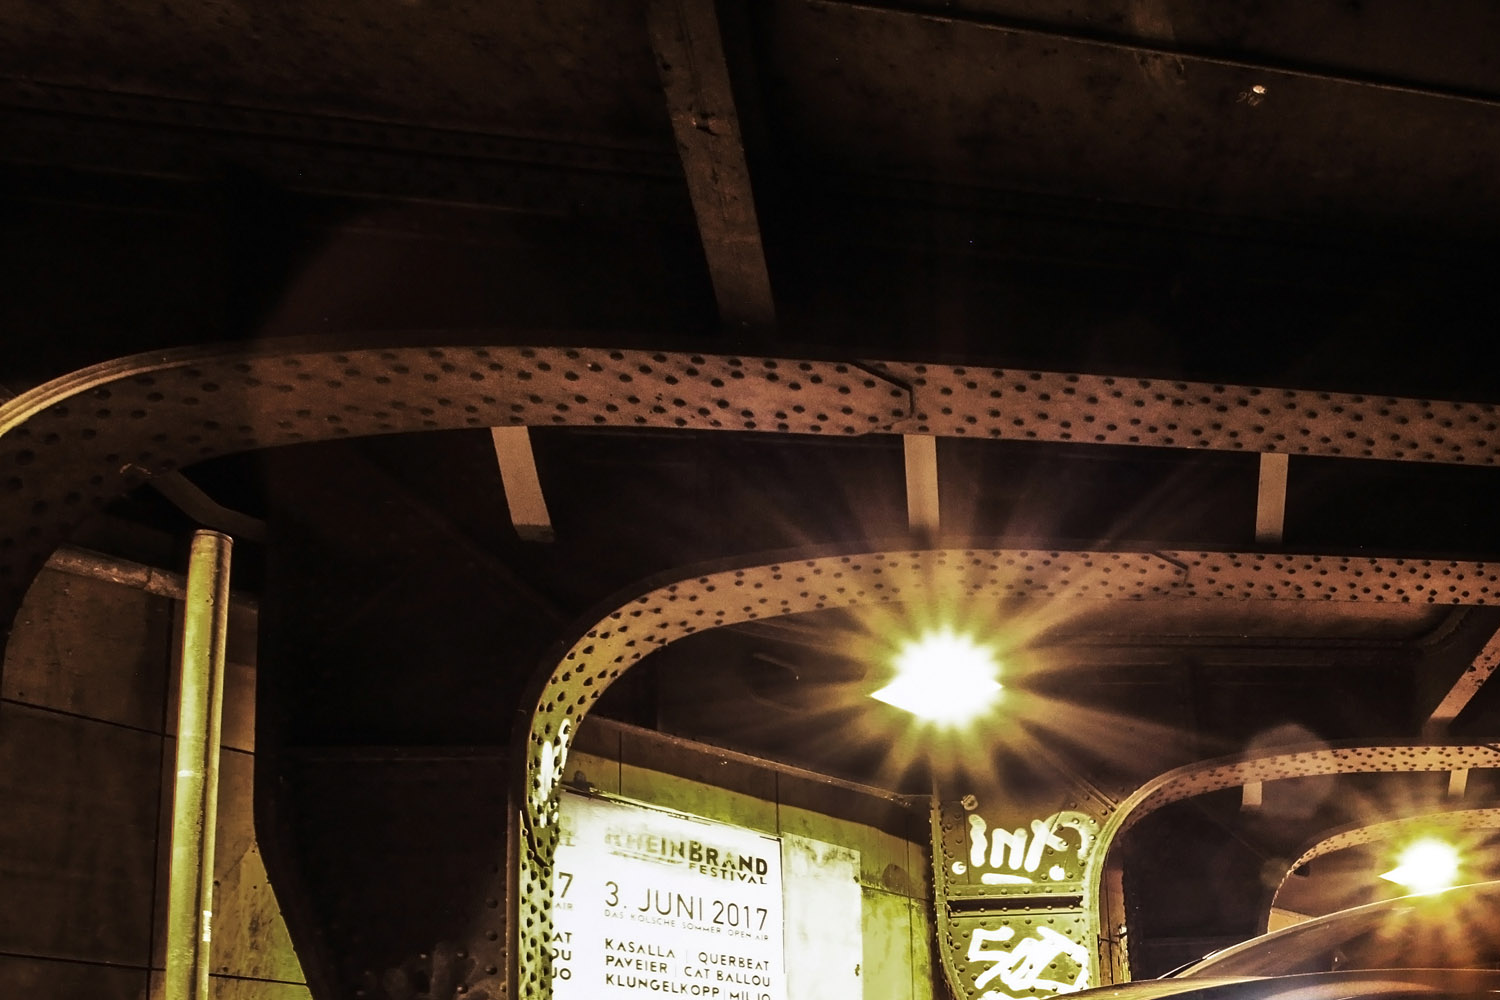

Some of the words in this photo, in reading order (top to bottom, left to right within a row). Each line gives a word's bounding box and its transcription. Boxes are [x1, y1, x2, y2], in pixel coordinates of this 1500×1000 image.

[688, 862, 768, 885] FESTIVAL
[604, 880, 627, 909] 3.
[637, 888, 703, 921] JUNI
[712, 900, 768, 931] 2017
[604, 909, 624, 920] DAS
[682, 921, 722, 934] SOMMER
[727, 929, 752, 938] OPEN
[604, 938, 675, 959] KASALLA
[698, 951, 770, 971] QUERBEAT
[605, 955, 668, 974] PAVEIER
[684, 965, 710, 979] CAT
[716, 969, 771, 988] BALLOU
